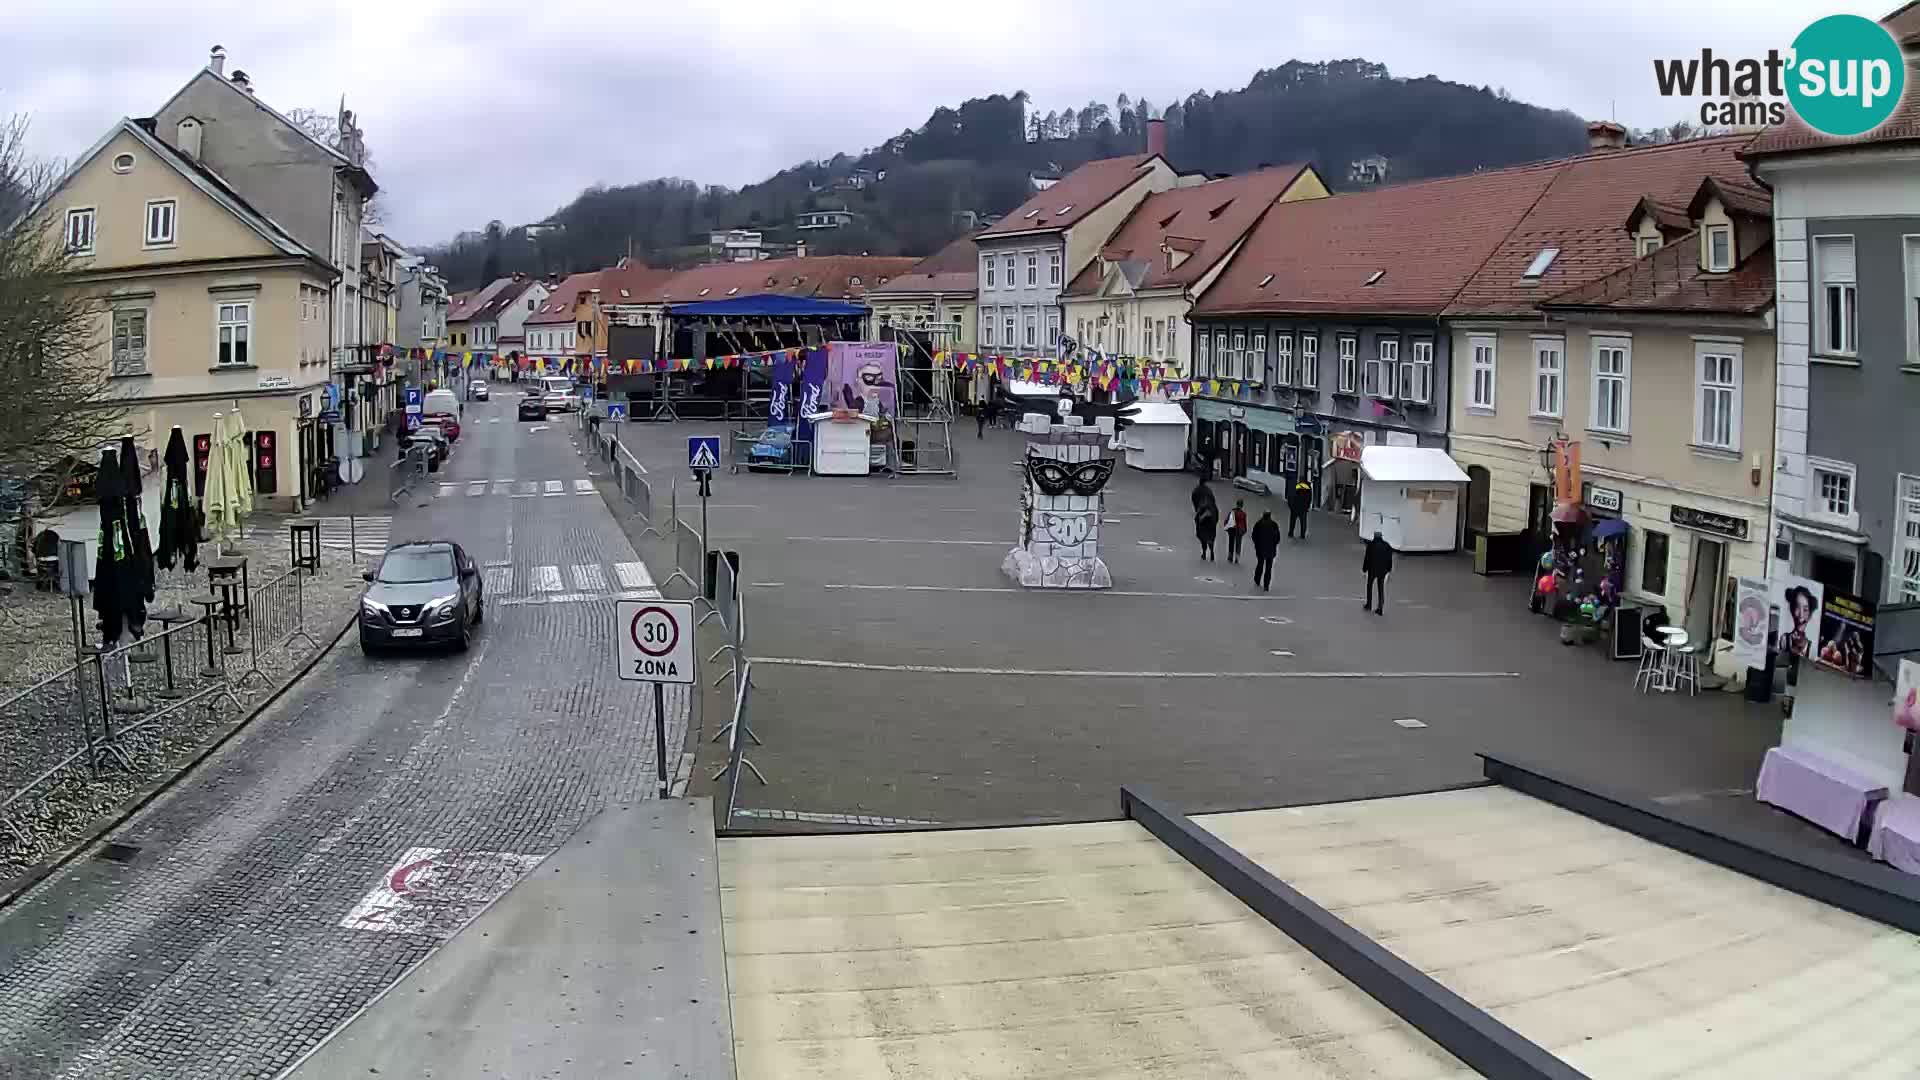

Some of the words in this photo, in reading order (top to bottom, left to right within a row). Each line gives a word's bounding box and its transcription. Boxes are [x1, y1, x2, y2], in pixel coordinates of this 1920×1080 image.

[409, 391, 417, 403] P
[770, 381, 788, 421] Ford
[800, 382, 820, 420] Ford
[1046, 516, 1088, 545] 200
[643, 622, 668, 643] 30
[634, 659, 678, 676] ZONA
